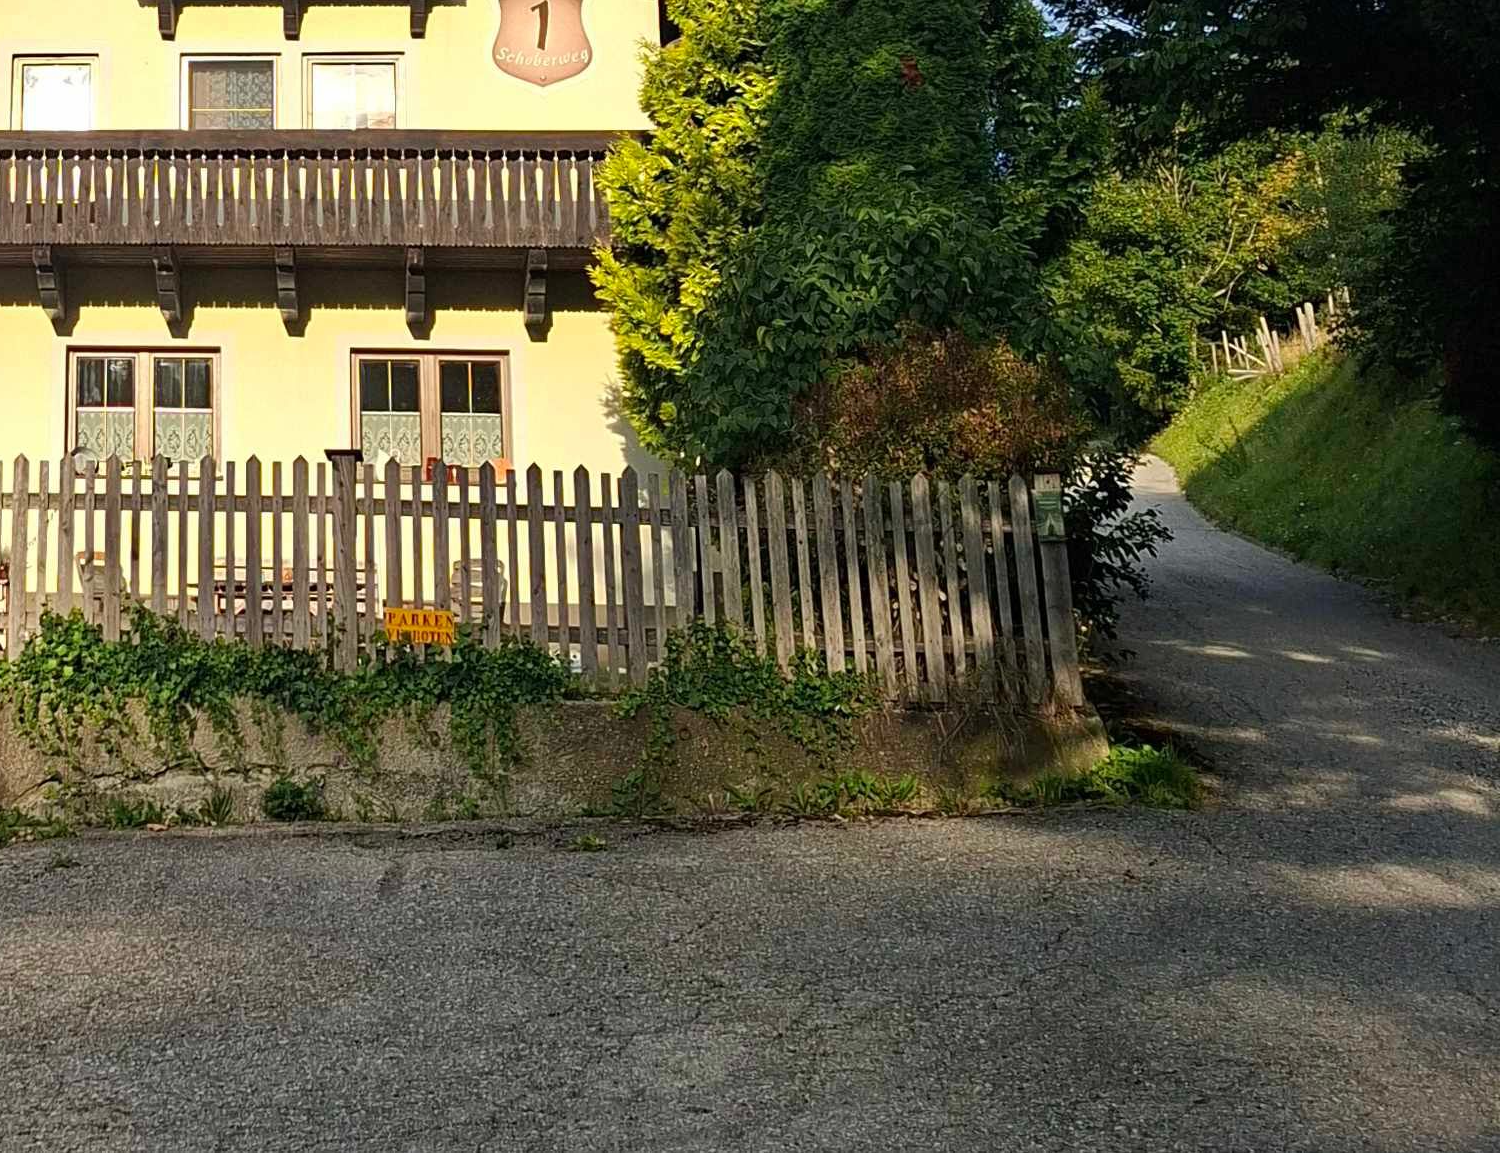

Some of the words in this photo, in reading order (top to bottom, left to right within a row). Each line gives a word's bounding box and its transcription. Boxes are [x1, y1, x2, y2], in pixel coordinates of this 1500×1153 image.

[530, 0, 549, 51] 1
[496, 47, 589, 67] Schoberweg
[388, 612, 454, 626] PARKEN
